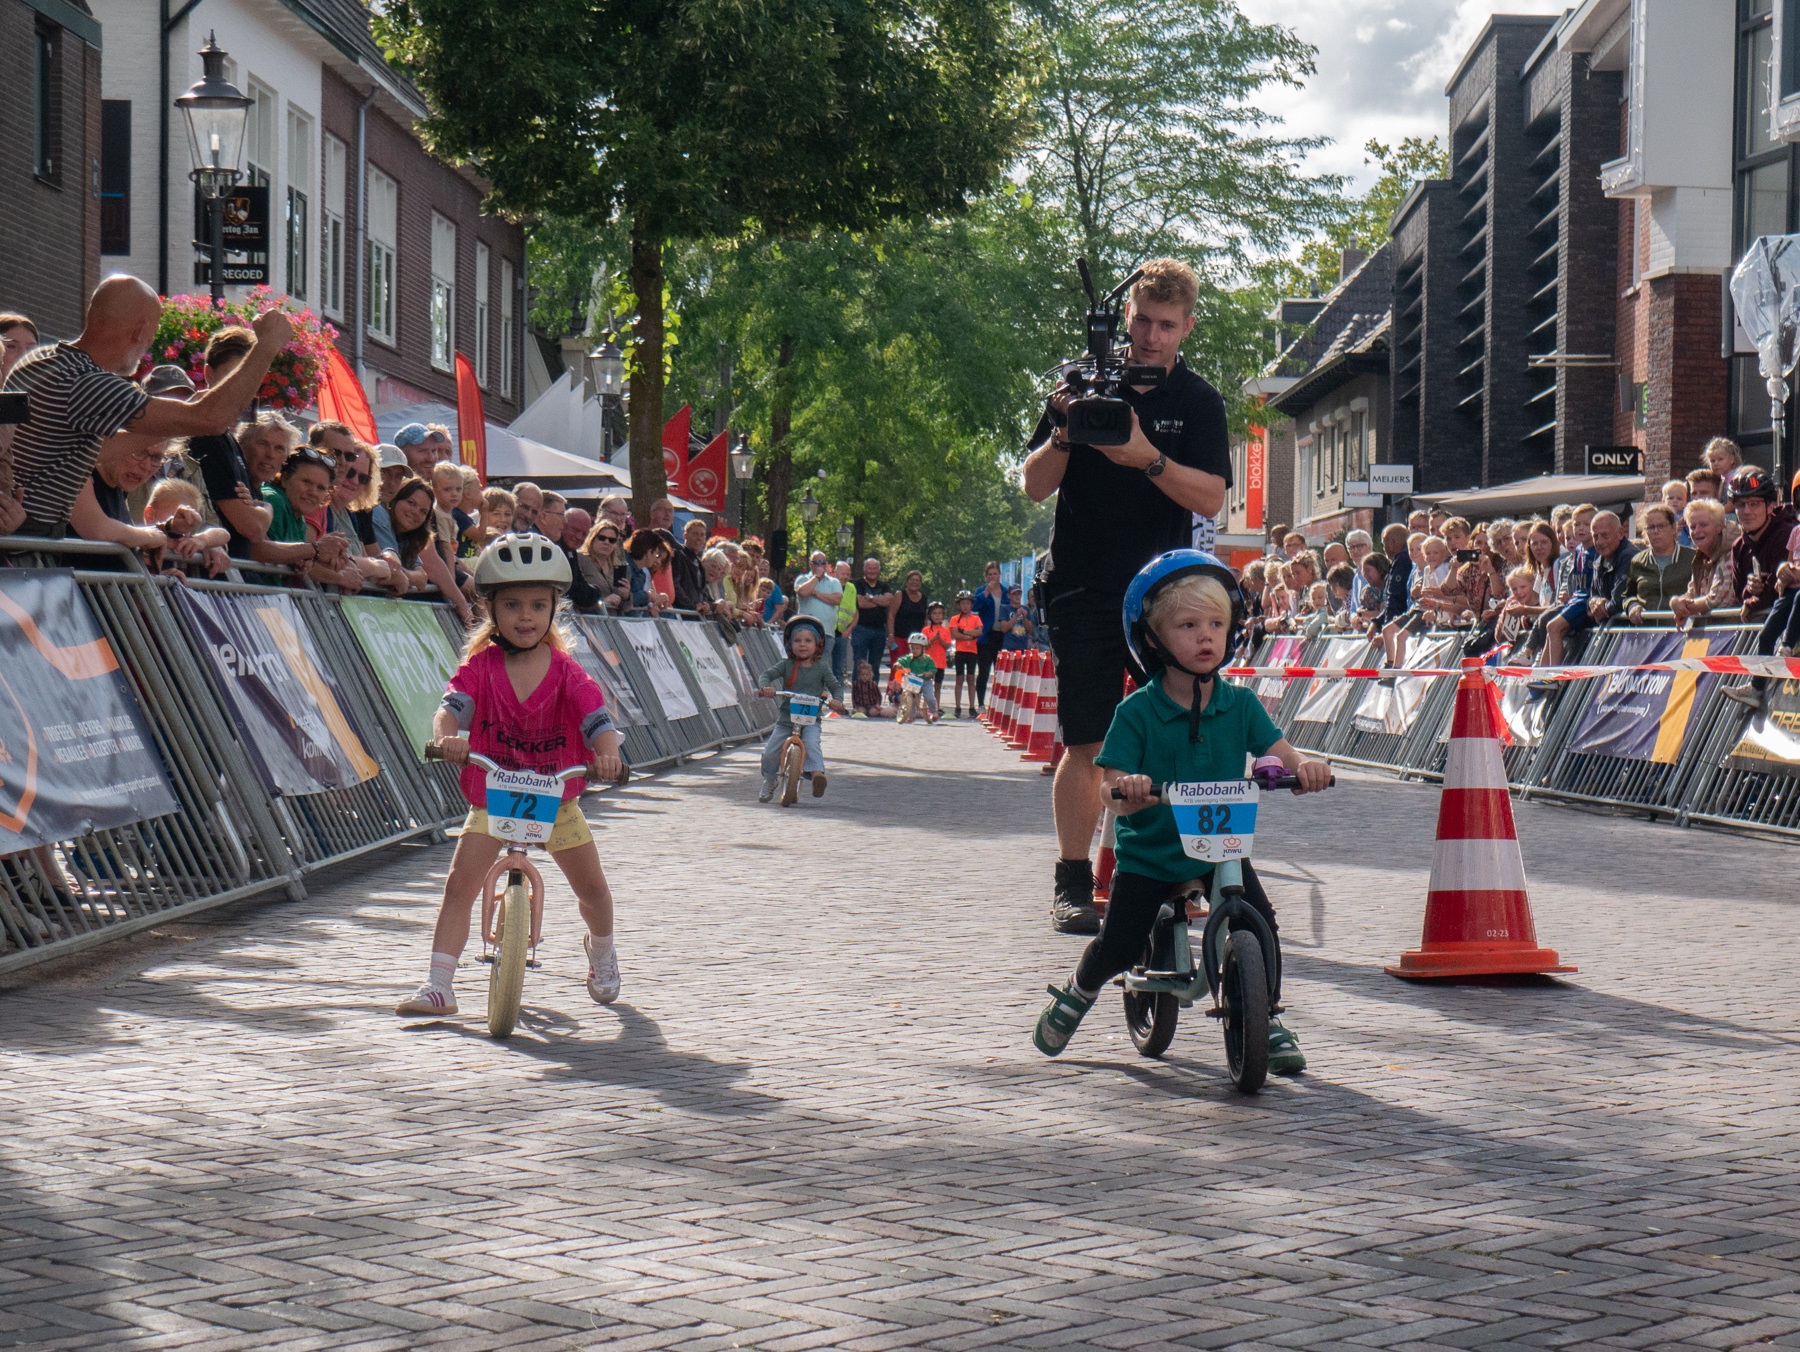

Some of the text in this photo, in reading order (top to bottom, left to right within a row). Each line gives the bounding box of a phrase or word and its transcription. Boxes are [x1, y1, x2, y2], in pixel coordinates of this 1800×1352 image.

[222, 225, 241, 235] ertog
[1250, 438, 1262, 489] blokke
[1592, 453, 1634, 465] ONLY
[1372, 475, 1411, 483] MEIJERS
[800, 704, 811, 715] 73
[496, 771, 553, 788] Rabobank
[1180, 783, 1245, 796] Rabobank
[509, 791, 538, 820] 72
[1197, 804, 1231, 834] 82
[1486, 929, 1509, 937] 02-23
